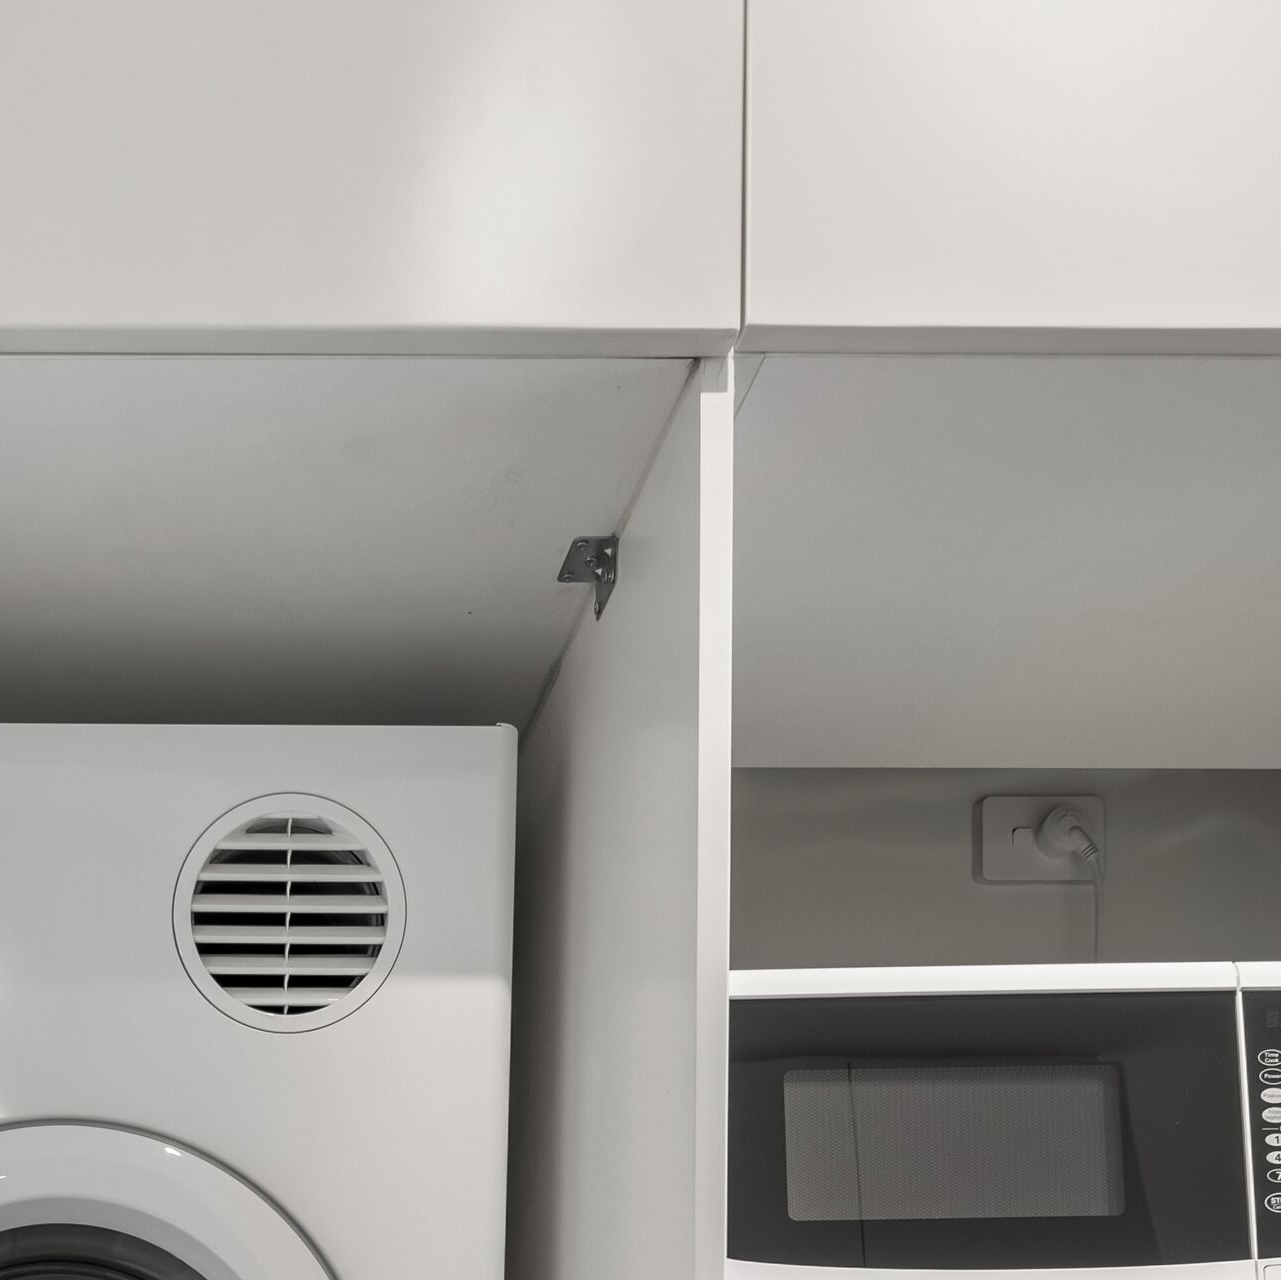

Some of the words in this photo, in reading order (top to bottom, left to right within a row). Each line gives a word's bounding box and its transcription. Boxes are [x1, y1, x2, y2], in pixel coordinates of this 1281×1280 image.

[1274, 1136, 1279, 1144] 1
[1275, 1153, 1281, 1162] 4
[1275, 1171, 1281, 1180] 7
